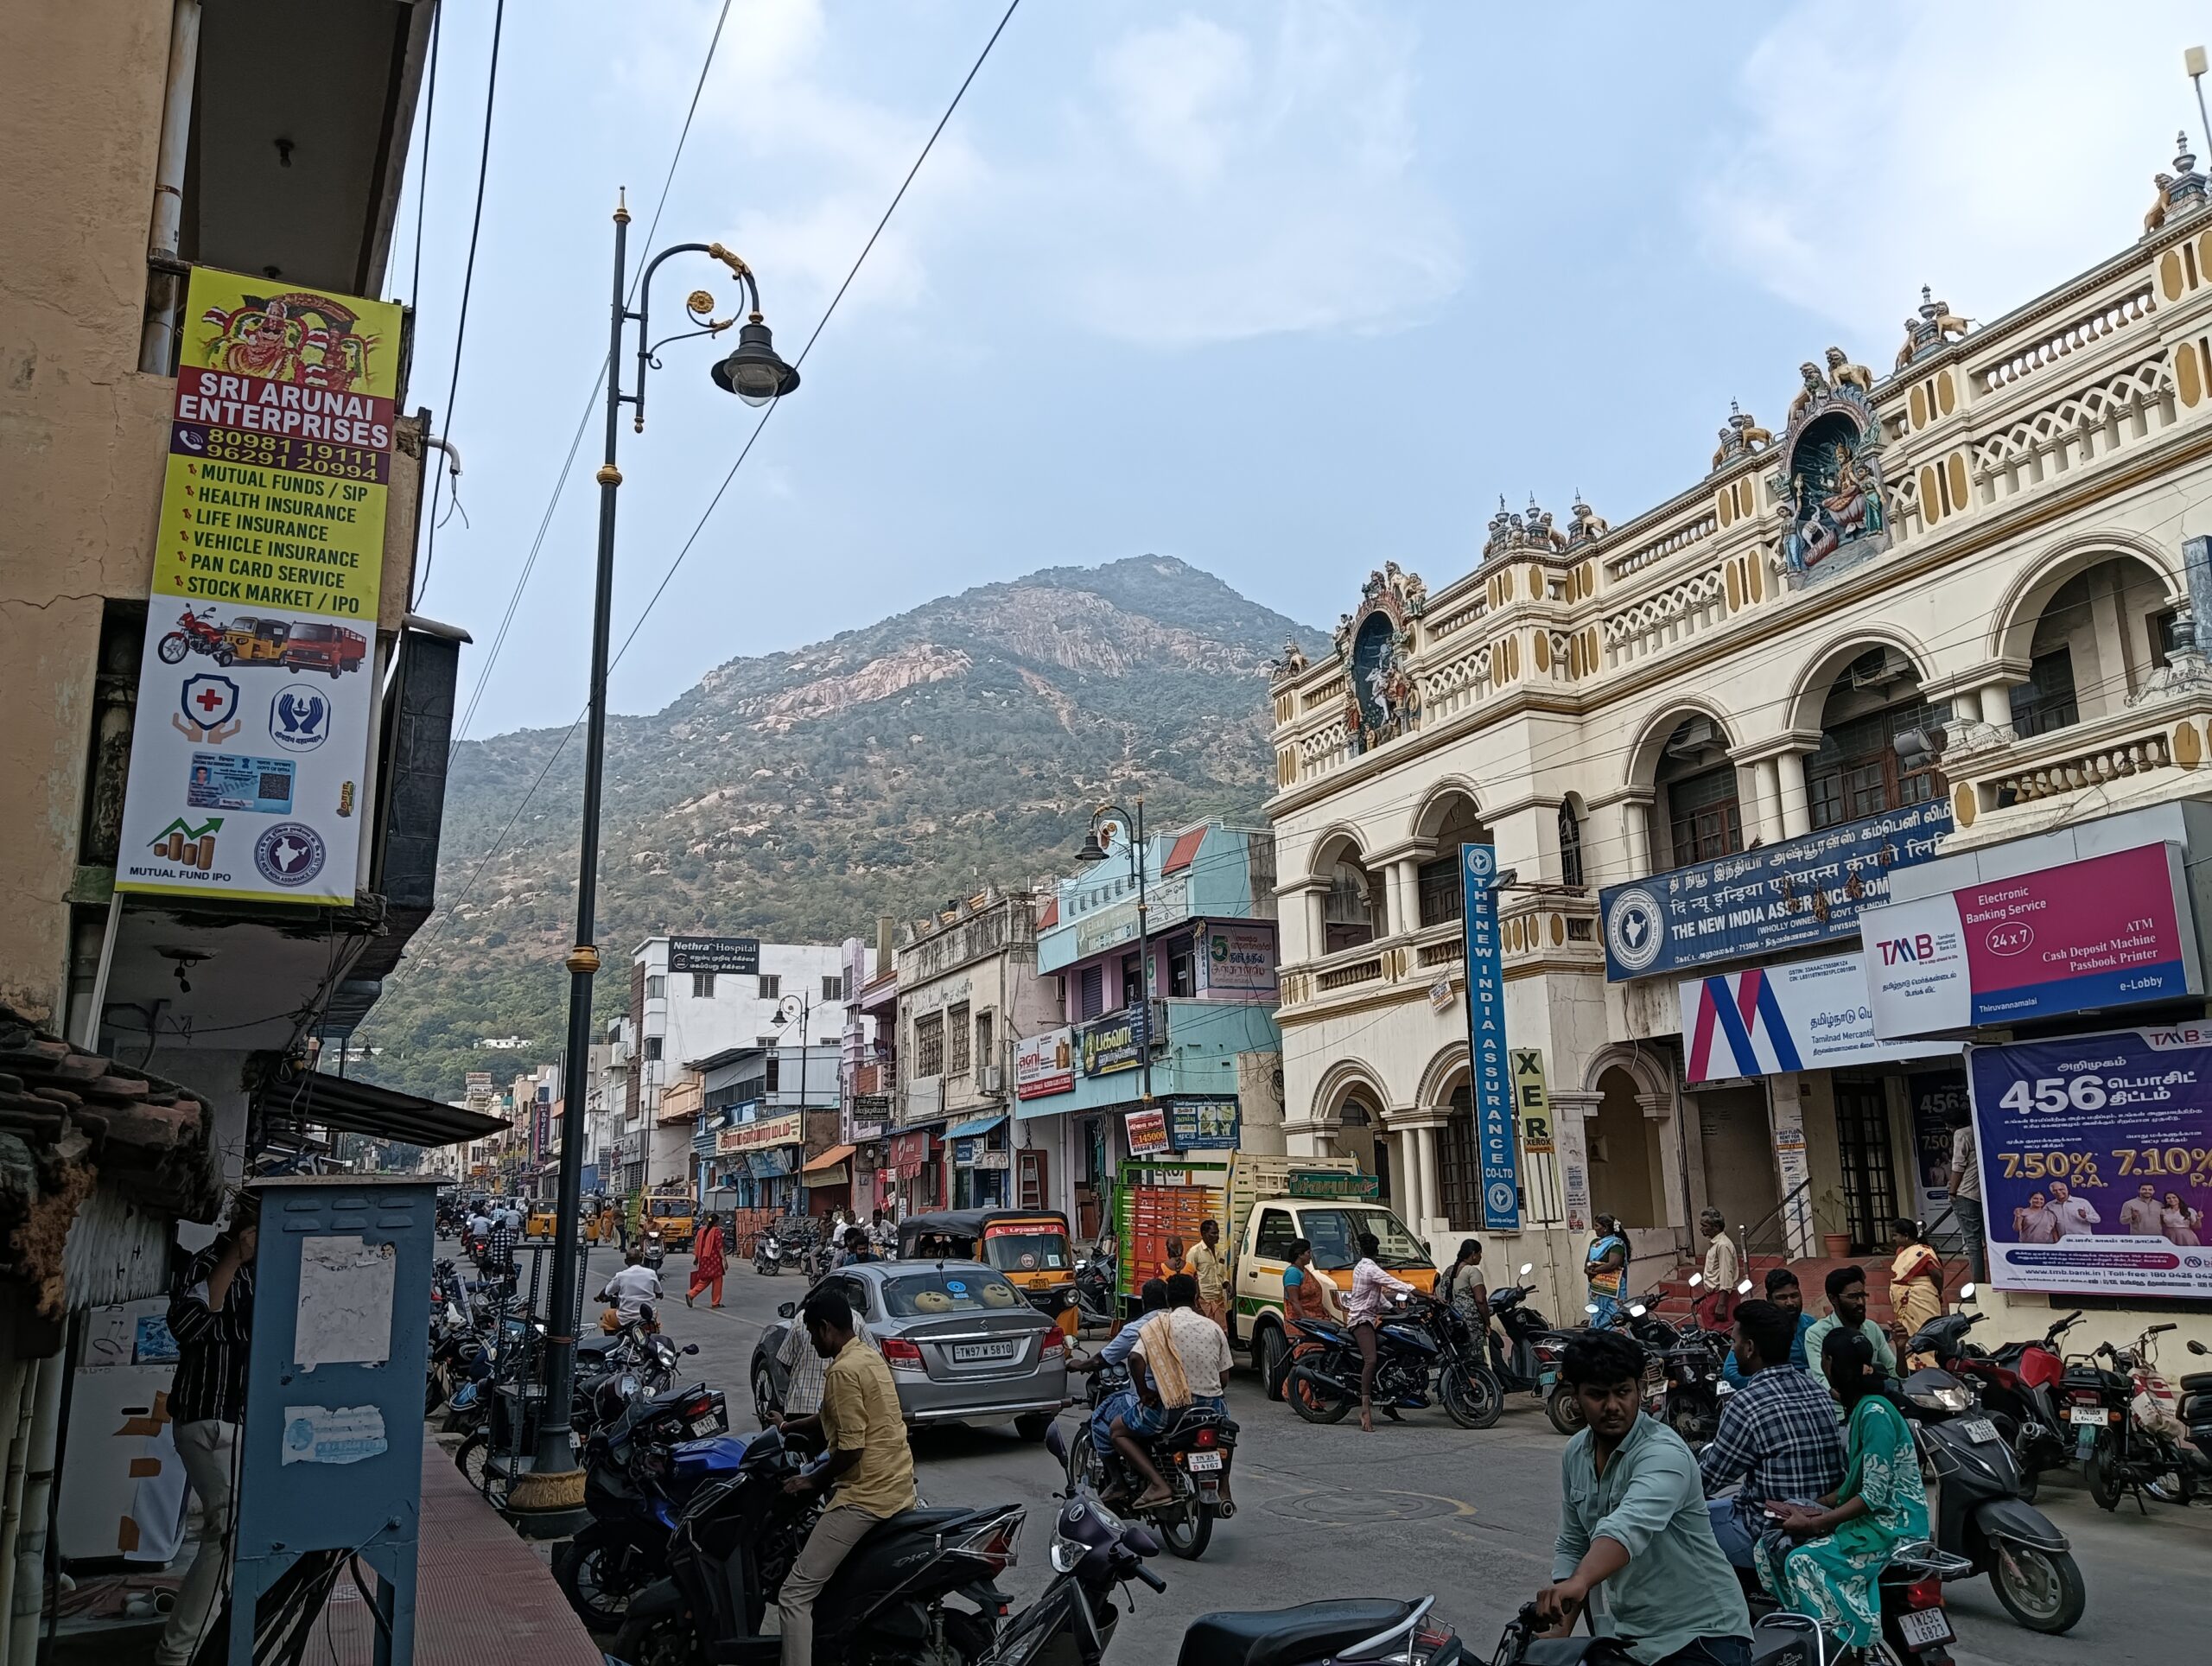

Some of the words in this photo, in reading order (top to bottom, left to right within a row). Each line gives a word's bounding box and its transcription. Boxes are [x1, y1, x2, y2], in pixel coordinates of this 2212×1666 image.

[200, 372, 249, 401] SRI
[258, 383, 373, 421] ARUNAI
[179, 394, 388, 448] ENTERPRISES
[209, 429, 290, 453] 80981
[302, 442, 377, 466] 19111
[207, 444, 287, 467] 96291
[297, 458, 378, 480] 20994
[201, 464, 266, 487] MUTUAL
[272, 474, 324, 496] FUNDS
[343, 485, 368, 501] SIP
[199, 487, 259, 509] HEALTH
[266, 496, 356, 523] INSURANCE
[196, 509, 231, 527] LIFE
[237, 514, 328, 541] INSURANCE
[194, 531, 262, 555] VEHICLE
[268, 541, 359, 568] INSURANCE
[191, 554, 223, 572] PAN
[229, 559, 272, 578] CARD
[278, 565, 345, 588] SERVICE
[188, 576, 241, 598] STOCK
[246, 584, 313, 607] MARKET
[333, 595, 359, 614] IPO
[1669, 874, 1679, 895] தி
[1685, 871, 1707, 891] நியூ
[1713, 857, 1762, 883] இந்தியா
[1861, 811, 1921, 840] கம்பெனி
[130, 867, 176, 878] MUTUAL
[179, 870, 209, 880] FUND
[213, 873, 231, 881] IPO
[1474, 878, 1488, 913] THE
[1690, 896, 1713, 914] न्यू
[1978, 887, 2029, 906] Electronic
[1790, 916, 1817, 931] OWNED
[1830, 906, 1853, 919] GOVT.
[1966, 906, 2006, 924] Banking
[2008, 899, 2047, 915] Service
[1671, 922, 1695, 940] THE
[1698, 914, 1726, 935] NEW
[1729, 909, 1764, 932] INDIA
[2126, 918, 2153, 933] ATM
[674, 941, 709, 951] Nethra
[716, 943, 756, 953] Hospital
[1211, 935, 1228, 962] 5
[1474, 921, 1493, 957] NEW
[1876, 933, 1935, 966] TMB
[1992, 935, 2007, 948] 24
[2010, 934, 2018, 944] x
[2019, 929, 2028, 942] 7
[2042, 950, 2067, 963] Cash
[2069, 942, 2108, 959] Deposit
[2110, 933, 2157, 951] Machine
[2069, 955, 2116, 972] Passbook
[2120, 950, 2158, 964] Printer
[2120, 976, 2163, 991] e-Lobby
[1479, 965, 1495, 1030] INDIA
[1979, 997, 2037, 1013] Thiruvannamalai
[1810, 1009, 1856, 1030] தமிழ்நாடு
[1811, 1034, 1841, 1044] Tamilnad
[2150, 1029, 2200, 1046] TMB
[2057, 1056, 2126, 1072] அறிமுகம்
[1483, 1039, 1504, 1164] ASSURANCE
[1999, 1074, 2107, 1115] 456
[2107, 1071, 2196, 1089] டெபாசிட்
[2109, 1086, 2171, 1107] திட்டம்
[1139, 1131, 1166, 1143] 145000
[1486, 1168, 1513, 1179] CO-LTD
[2070, 1173, 2108, 1188] P.A.
[2025, 1268, 2101, 1276] www.tmb.bank.in
[2108, 1269, 2148, 1278] Toll-free:
[961, 1347, 980, 1357] TN97
[990, 1345, 1011, 1355] 5810
[1914, 1623, 1945, 1642] L6823
